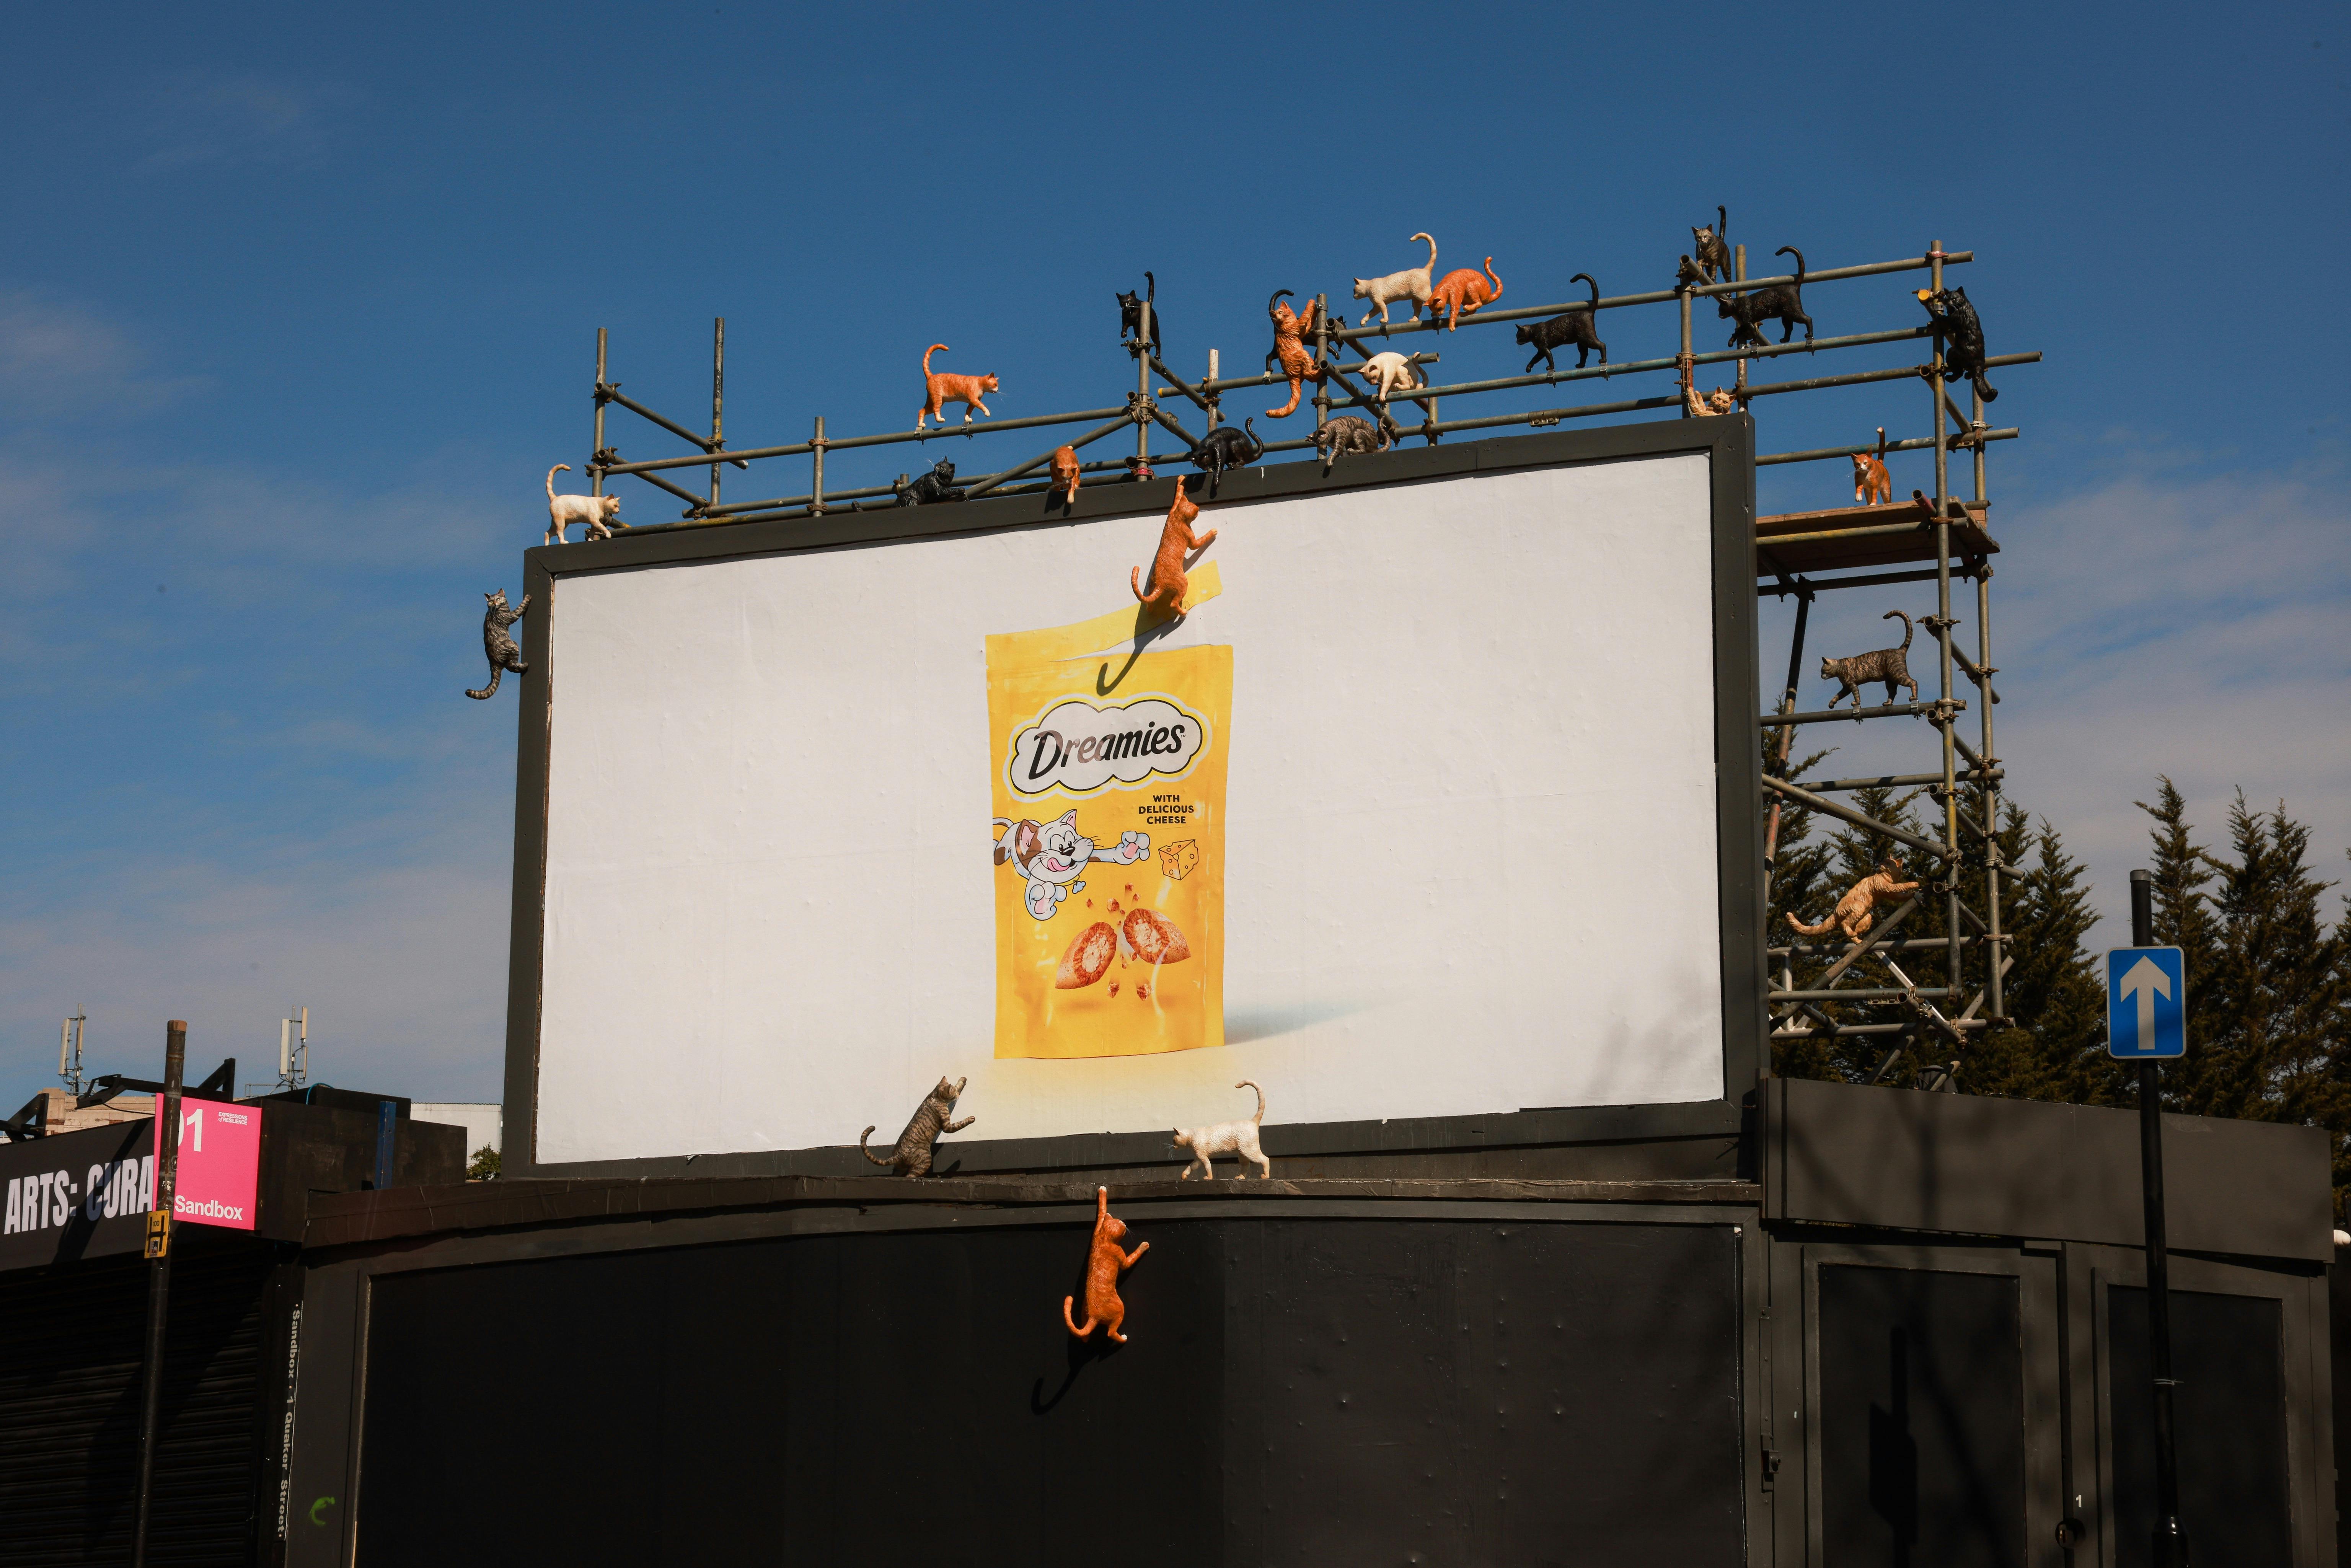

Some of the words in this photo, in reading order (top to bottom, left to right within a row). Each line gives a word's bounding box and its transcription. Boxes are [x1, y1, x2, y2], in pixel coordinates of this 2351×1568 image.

[1028, 721, 1185, 780] Dreamies
[1138, 805, 1194, 814] DELICIOUS
[1147, 816, 1186, 824] CHEESE
[218, 1112, 248, 1120] EXPRESSIONS
[223, 1117, 248, 1125] RESILIENCE
[4, 1170, 77, 1235] ARTS:
[174, 1195, 243, 1221] Sandbox
[288, 1310, 300, 1378] Sandbox
[282, 1412, 292, 1470] Quaker
[278, 1480, 288, 1532] Street
[2076, 1495, 2082, 1508] 1
